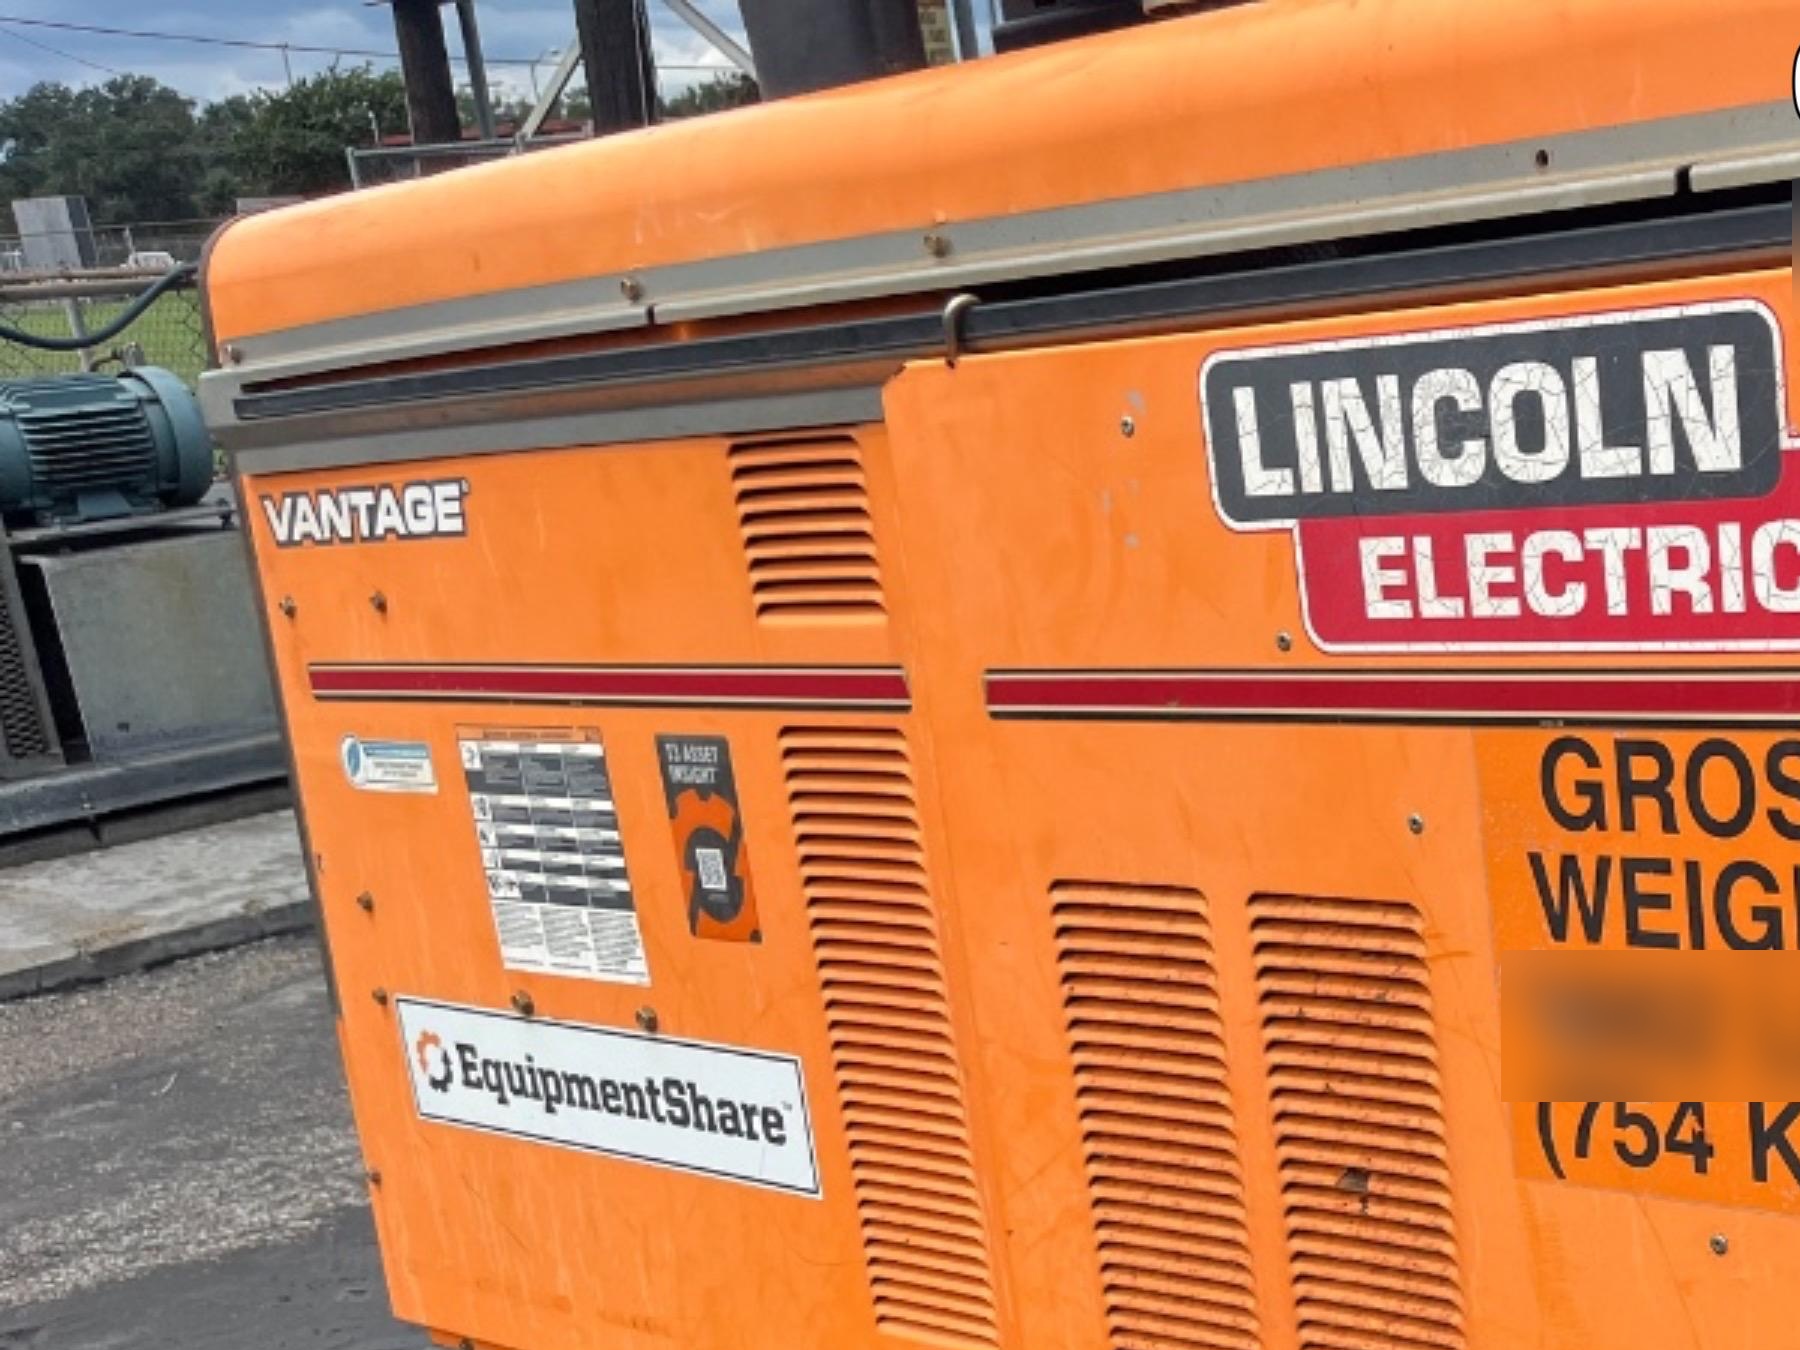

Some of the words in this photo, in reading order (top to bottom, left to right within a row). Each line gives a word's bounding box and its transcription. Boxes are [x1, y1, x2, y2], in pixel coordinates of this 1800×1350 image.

[1233, 344, 1743, 497] LINCOLN
[261, 480, 465, 544] VANTAGE
[456, 1043, 788, 1145] EquipmentShare
